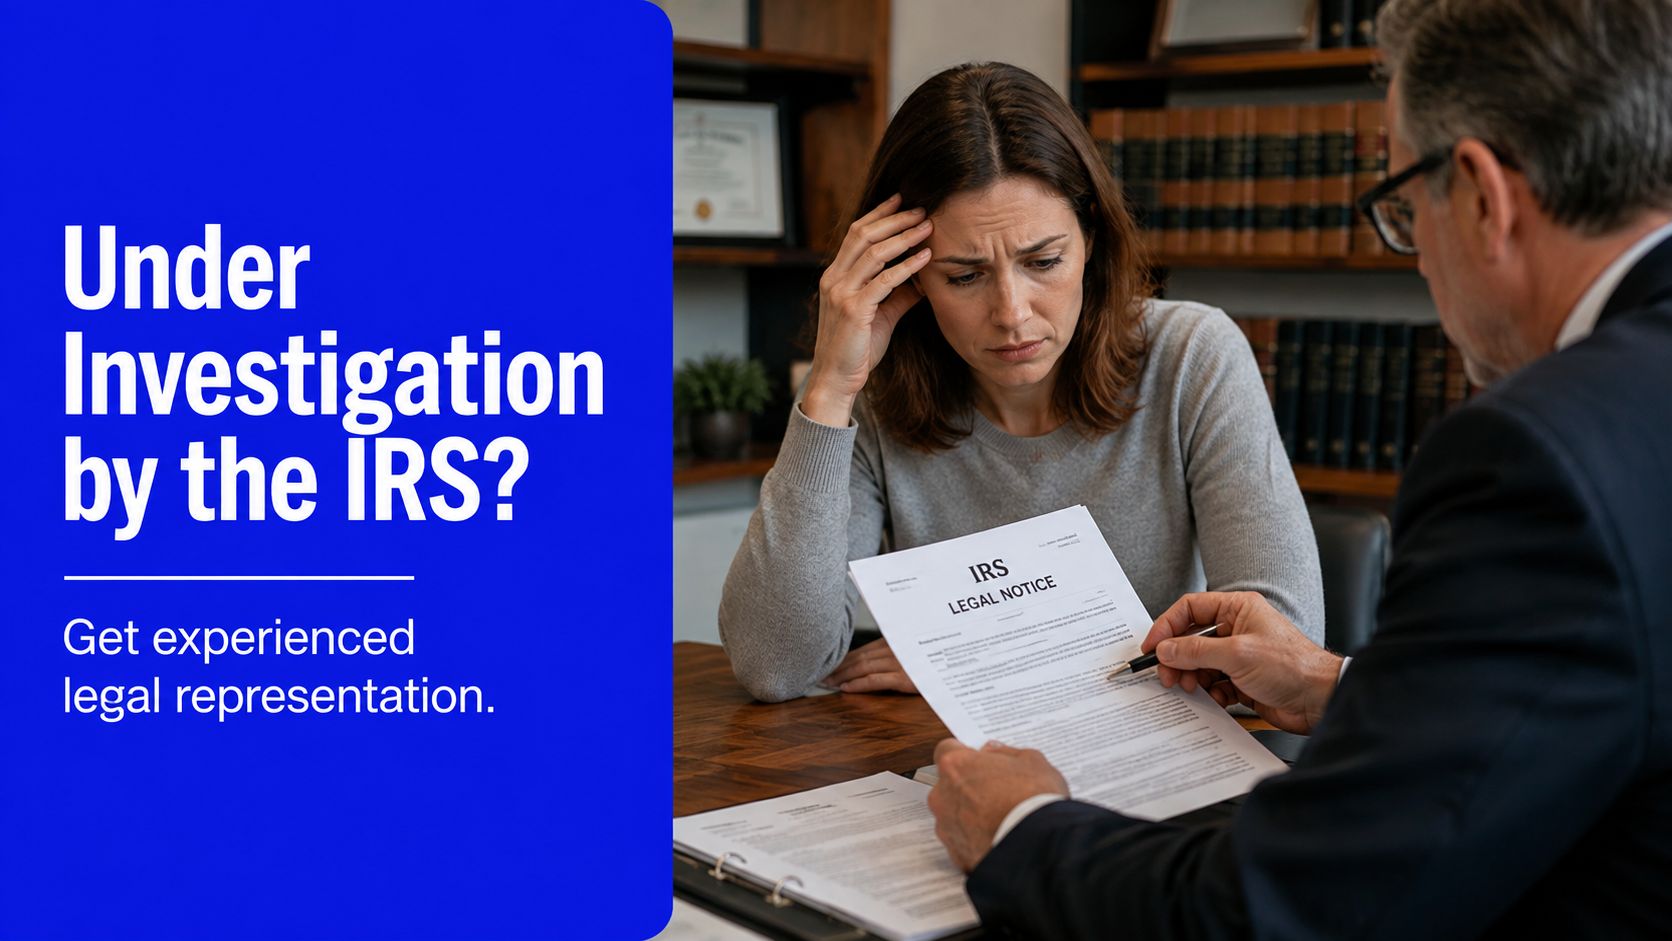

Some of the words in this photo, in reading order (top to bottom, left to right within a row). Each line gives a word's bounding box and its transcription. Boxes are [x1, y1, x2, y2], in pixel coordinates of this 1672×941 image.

[968, 558, 1010, 584] IRS
[948, 595, 1000, 615] LEGAL
[1000, 575, 1057, 602] NOTICE
